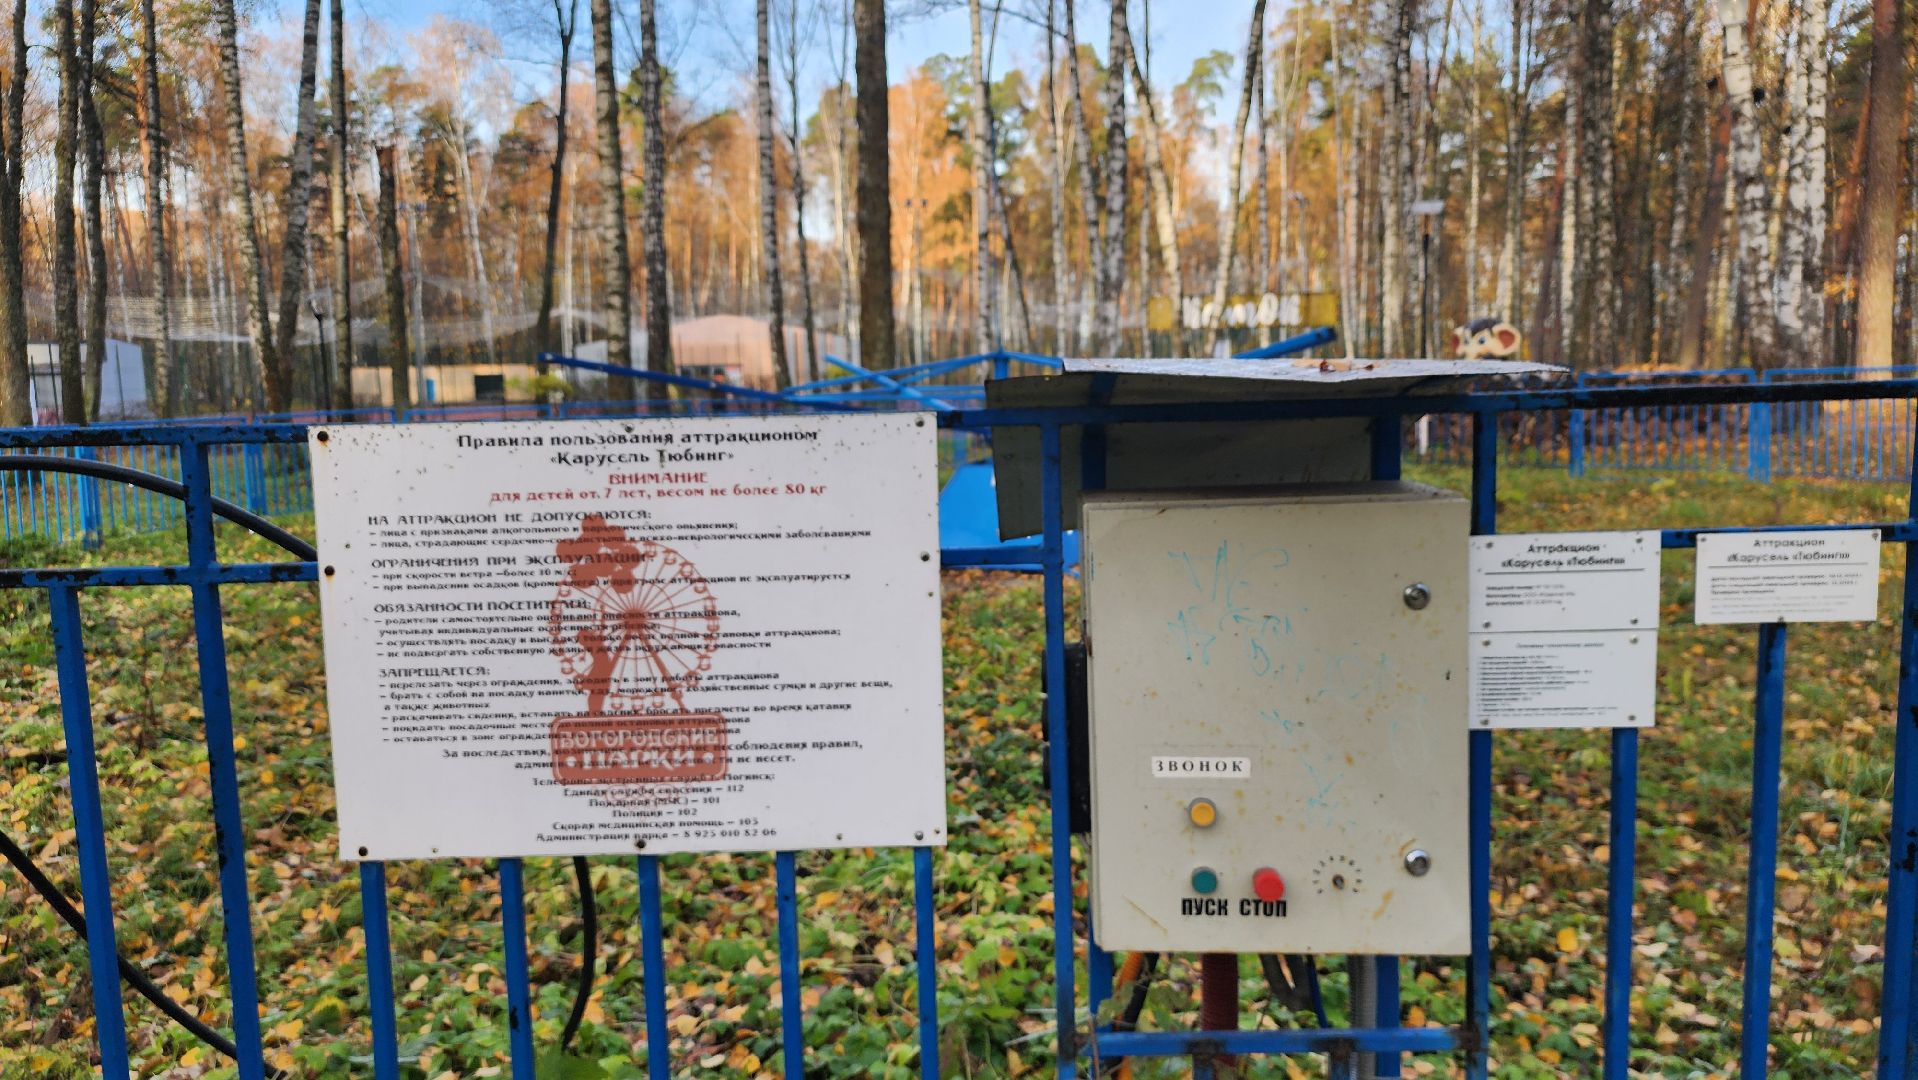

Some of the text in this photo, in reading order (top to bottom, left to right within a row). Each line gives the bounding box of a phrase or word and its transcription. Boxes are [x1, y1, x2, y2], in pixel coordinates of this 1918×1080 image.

[456, 429, 817, 449] Правила пользования аттракционом
[550, 449, 650, 466] «Карусель
[609, 471, 708, 485] ВНИМАНИЕ
[490, 483, 826, 503] для детей от 7 лет, весом не более 80 кг
[367, 509, 651, 526] НА АТТРАКЦИОН НЕ ДОПУСКАЮТСЯ:
[1527, 543, 1601, 555] Аттракцион
[371, 556, 479, 569] ОГРАНИЧЕНИЯ
[486, 555, 516, 566] ПРИ
[373, 601, 483, 614] ОБЯЗАННОСТИ
[378, 665, 490, 679] ЗАПРЕЩАЕТСЯ:
[1155, 760, 1244, 773] ЗВОНОК
[1181, 897, 1229, 917] ПУСК
[1239, 897, 1288, 918] СТОП
